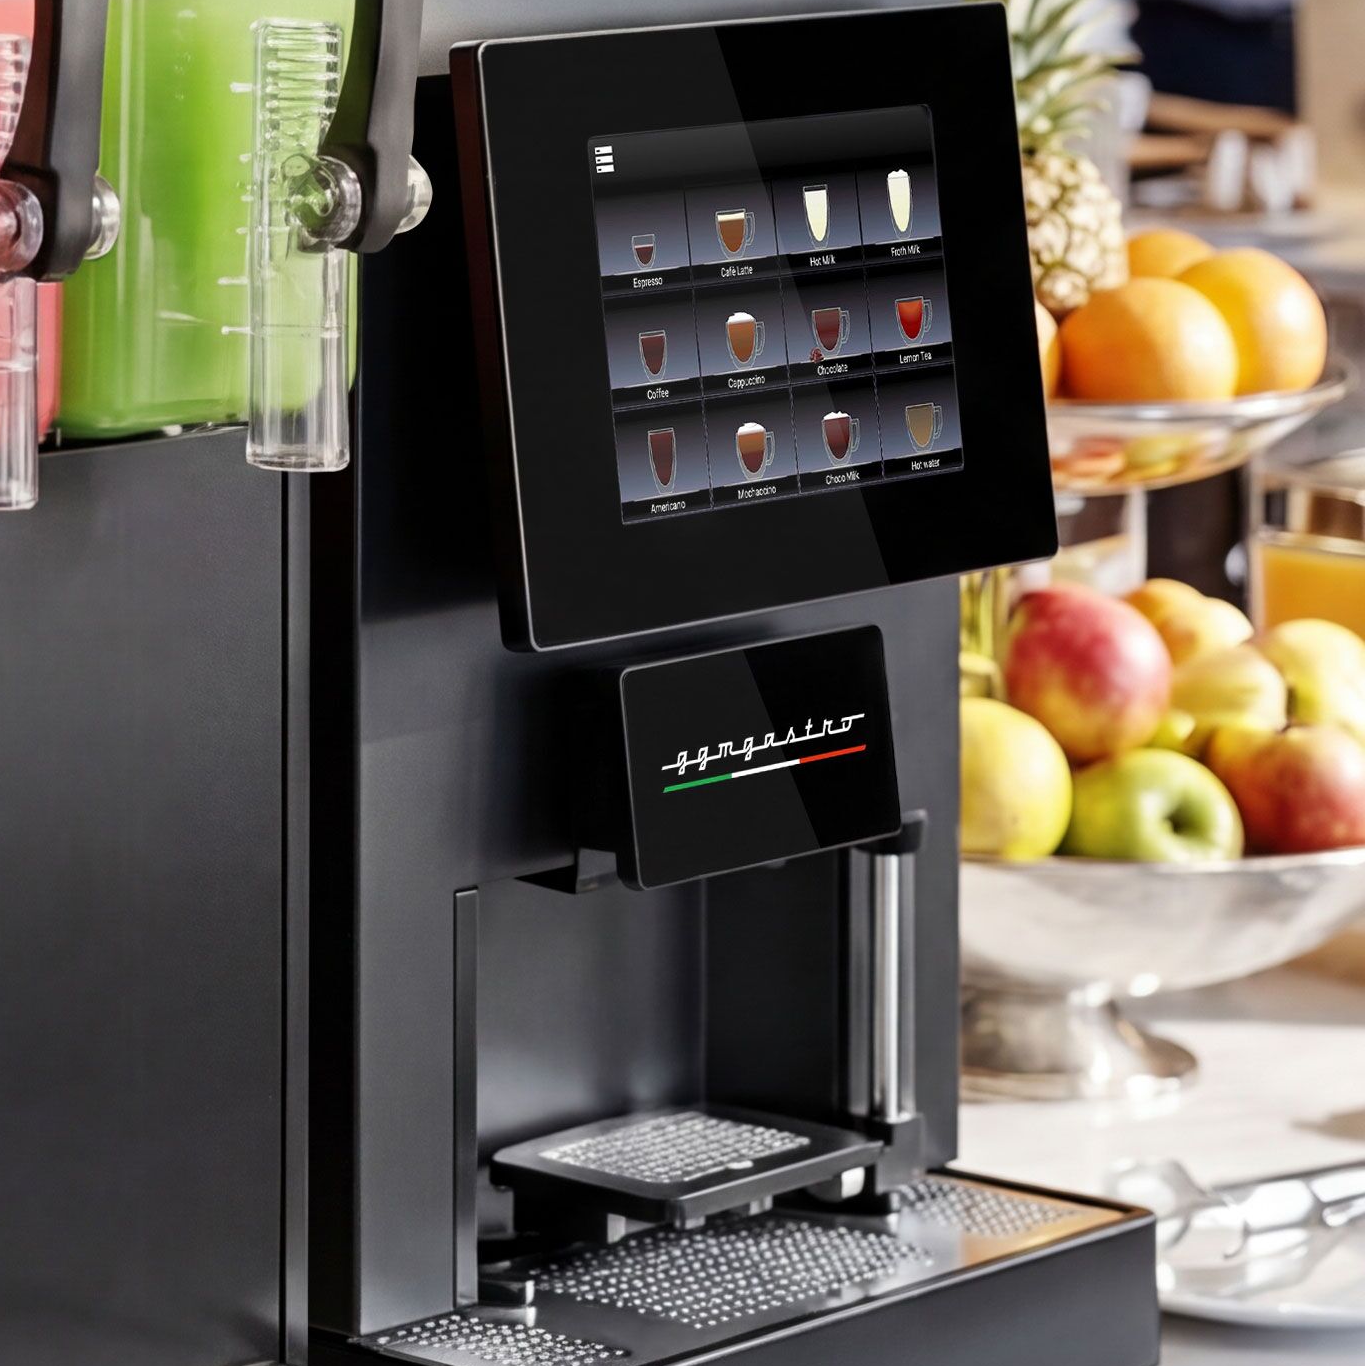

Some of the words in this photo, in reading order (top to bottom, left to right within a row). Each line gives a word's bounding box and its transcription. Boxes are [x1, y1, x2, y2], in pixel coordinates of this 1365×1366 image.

[737, 265, 753, 276] Latte
[633, 276, 663, 289] Espresso
[900, 354, 919, 363] Lemon
[921, 351, 932, 360] Tea
[647, 388, 669, 399] Coffee
[651, 501, 686, 513] Americano
[662, 713, 865, 775] ggmgastro
